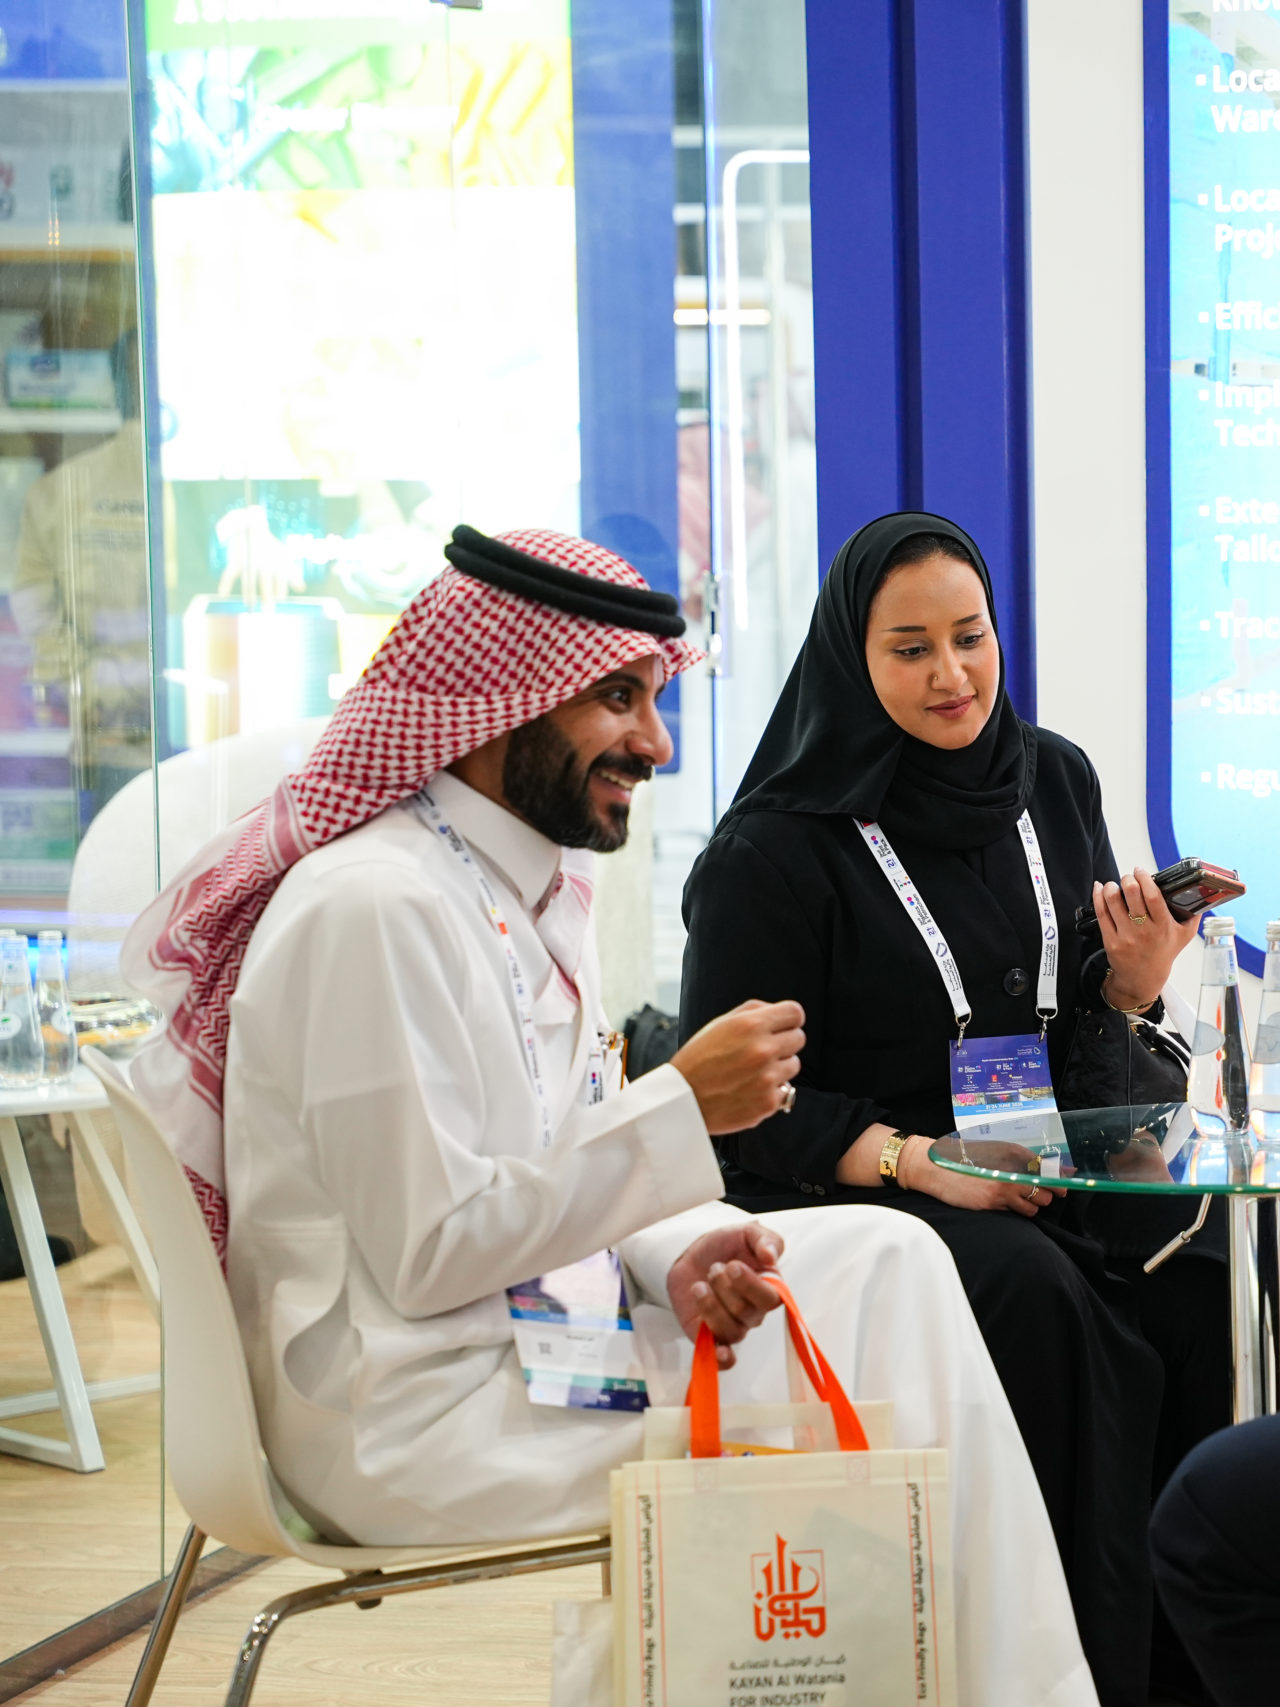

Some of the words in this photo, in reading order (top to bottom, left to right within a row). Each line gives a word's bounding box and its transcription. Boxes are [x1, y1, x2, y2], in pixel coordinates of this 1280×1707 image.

[877, 844, 886, 857] Print
[879, 838, 889, 851] Pack
[886, 858, 896, 868] 21
[914, 905, 927, 925] Plastics
[1044, 909, 1051, 918] 21
[927, 927, 936, 936] 21
[916, 1622, 928, 1645] Bags
[644, 1638, 656, 1661] Bags
[729, 1676, 773, 1690] KAYAN
[794, 1671, 845, 1685] Watania
[730, 1695, 756, 1707] FOR
[760, 1692, 825, 1706] INDUSTRY
